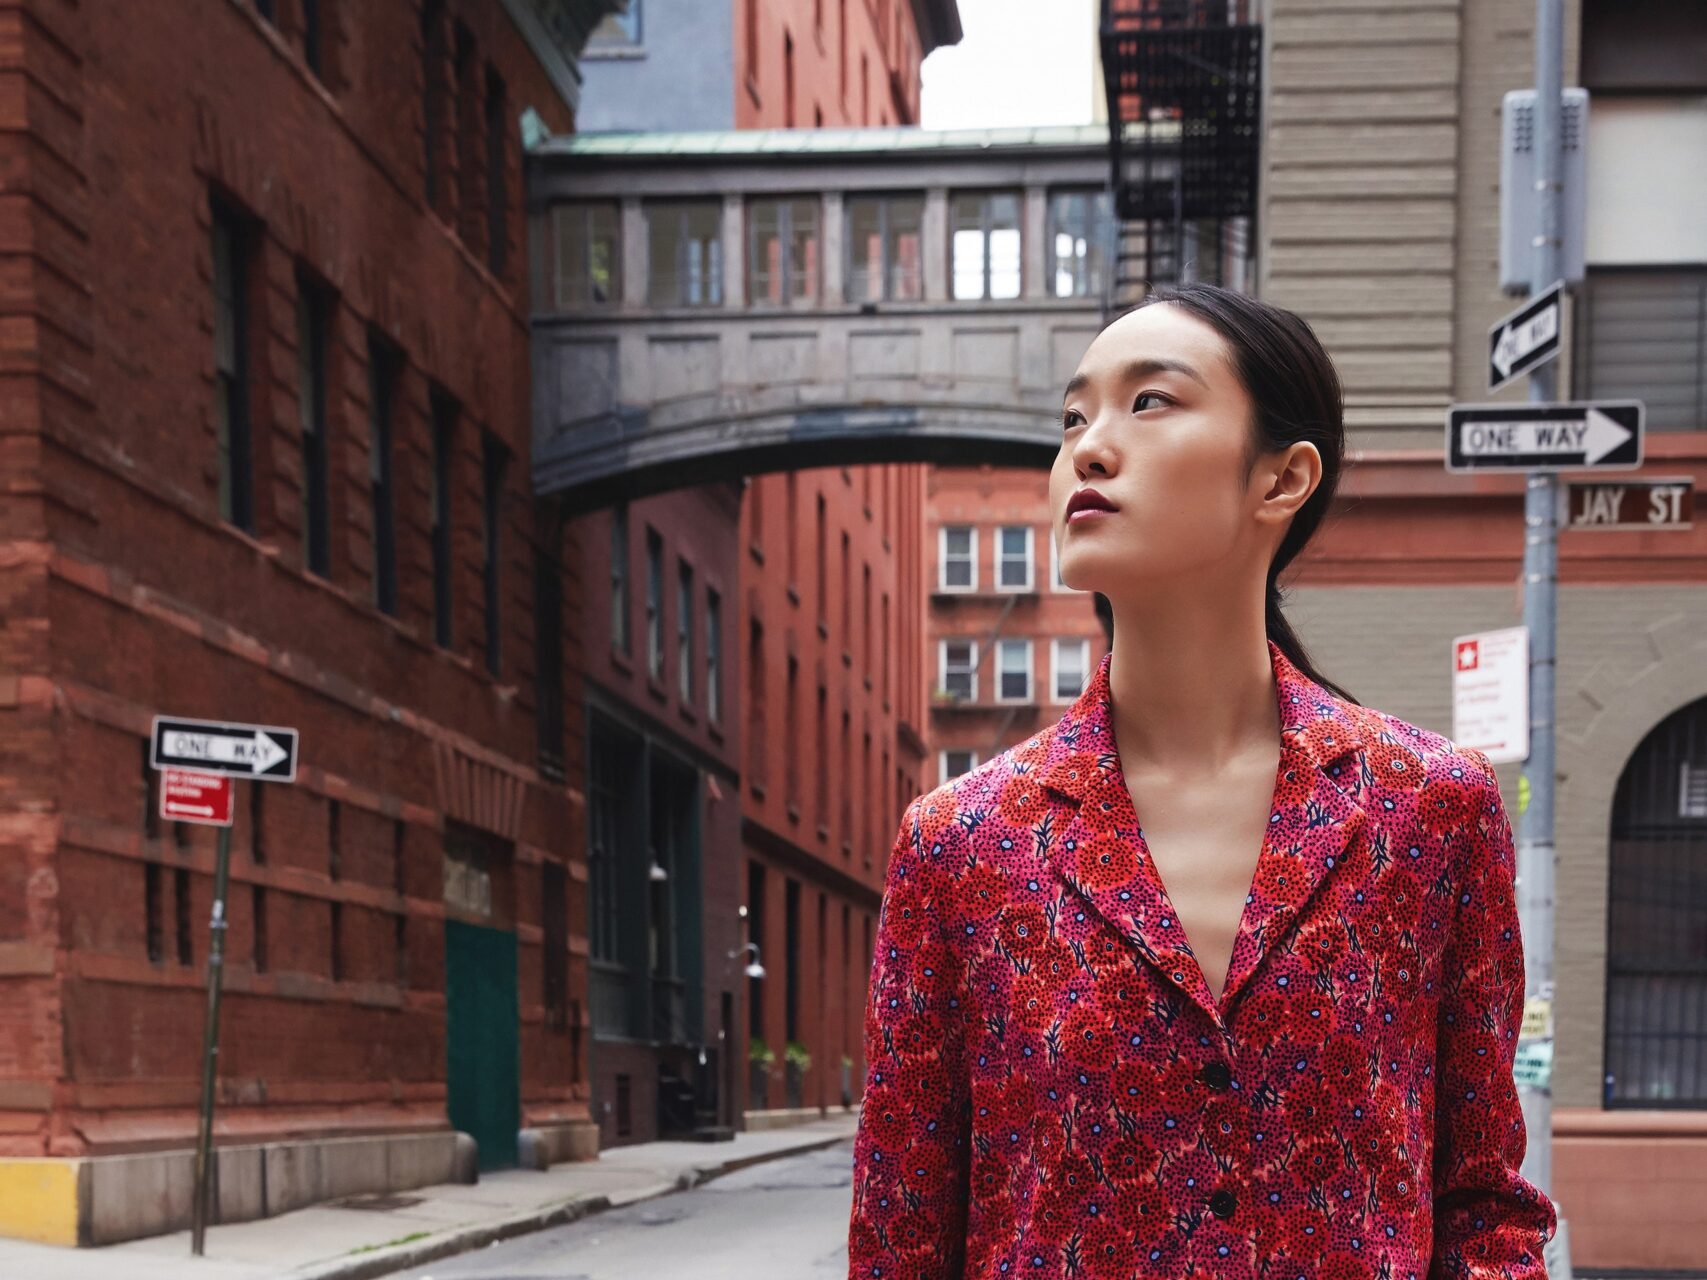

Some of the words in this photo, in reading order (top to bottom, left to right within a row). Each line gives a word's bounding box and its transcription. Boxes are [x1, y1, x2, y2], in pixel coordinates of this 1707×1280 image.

[1469, 426, 1519, 450] ONE
[1534, 425, 1588, 448] WAY
[1574, 487, 1625, 525] JAY
[1648, 486, 1687, 524] ST
[174, 732, 215, 759] ONE
[234, 742, 271, 761] WAY
